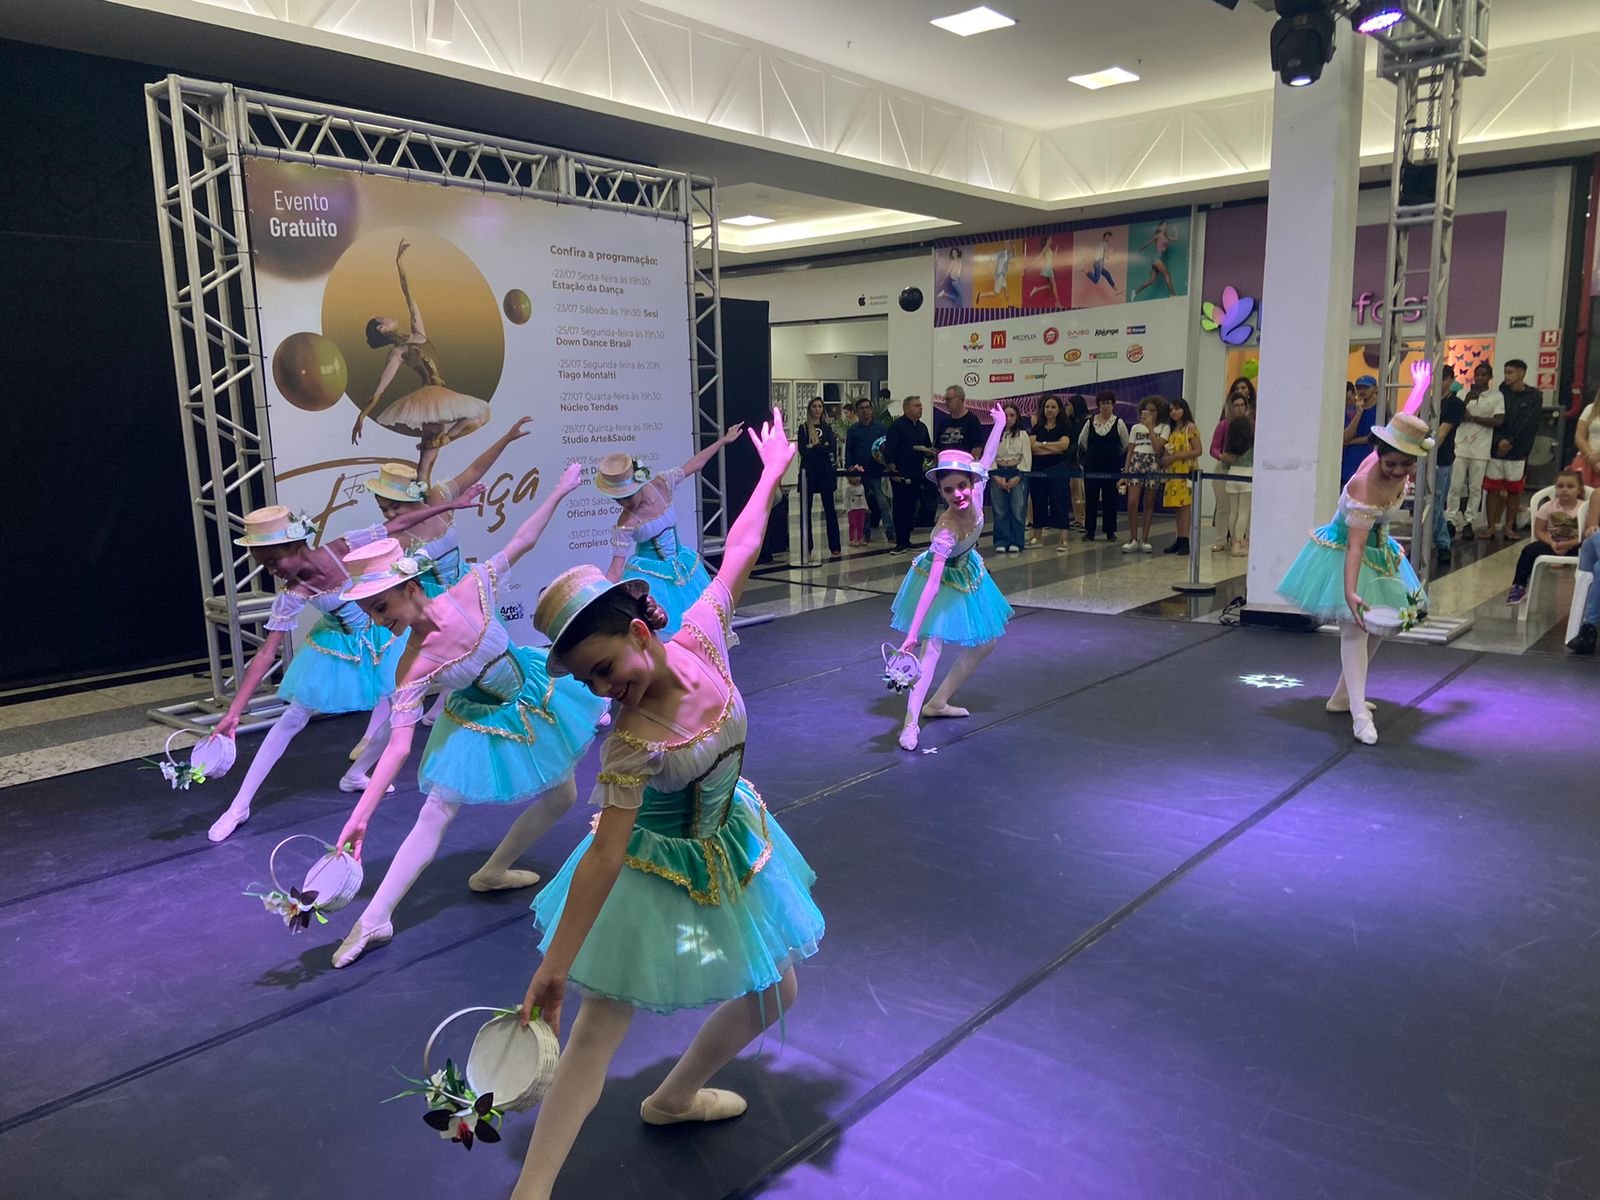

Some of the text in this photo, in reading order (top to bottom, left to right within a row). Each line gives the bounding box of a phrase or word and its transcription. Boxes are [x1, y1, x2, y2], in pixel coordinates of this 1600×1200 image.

[274, 190, 329, 211] Evento
[269, 217, 338, 237] Gratuito
[550, 245, 658, 267] Confira a programação:
[552, 280, 624, 296] Estação da Dança
[579, 304, 609, 315] Sábado
[643, 309, 659, 318] Sesi
[581, 327, 634, 338] Segunda-feira
[555, 337, 632, 349] Down Dance Brasil
[583, 360, 635, 370] Segunda-feira
[558, 370, 617, 381] Tiago Montalti
[584, 392, 630, 402] Quarta-feira
[560, 402, 619, 412] Núcleo Tendas
[587, 423, 632, 433] Quinta-feira
[562, 433, 636, 445] Studio Arte&Saúde
[567, 507, 596, 519] Oficina
[598, 508, 608, 516] do
[569, 538, 609, 550] Complexo
